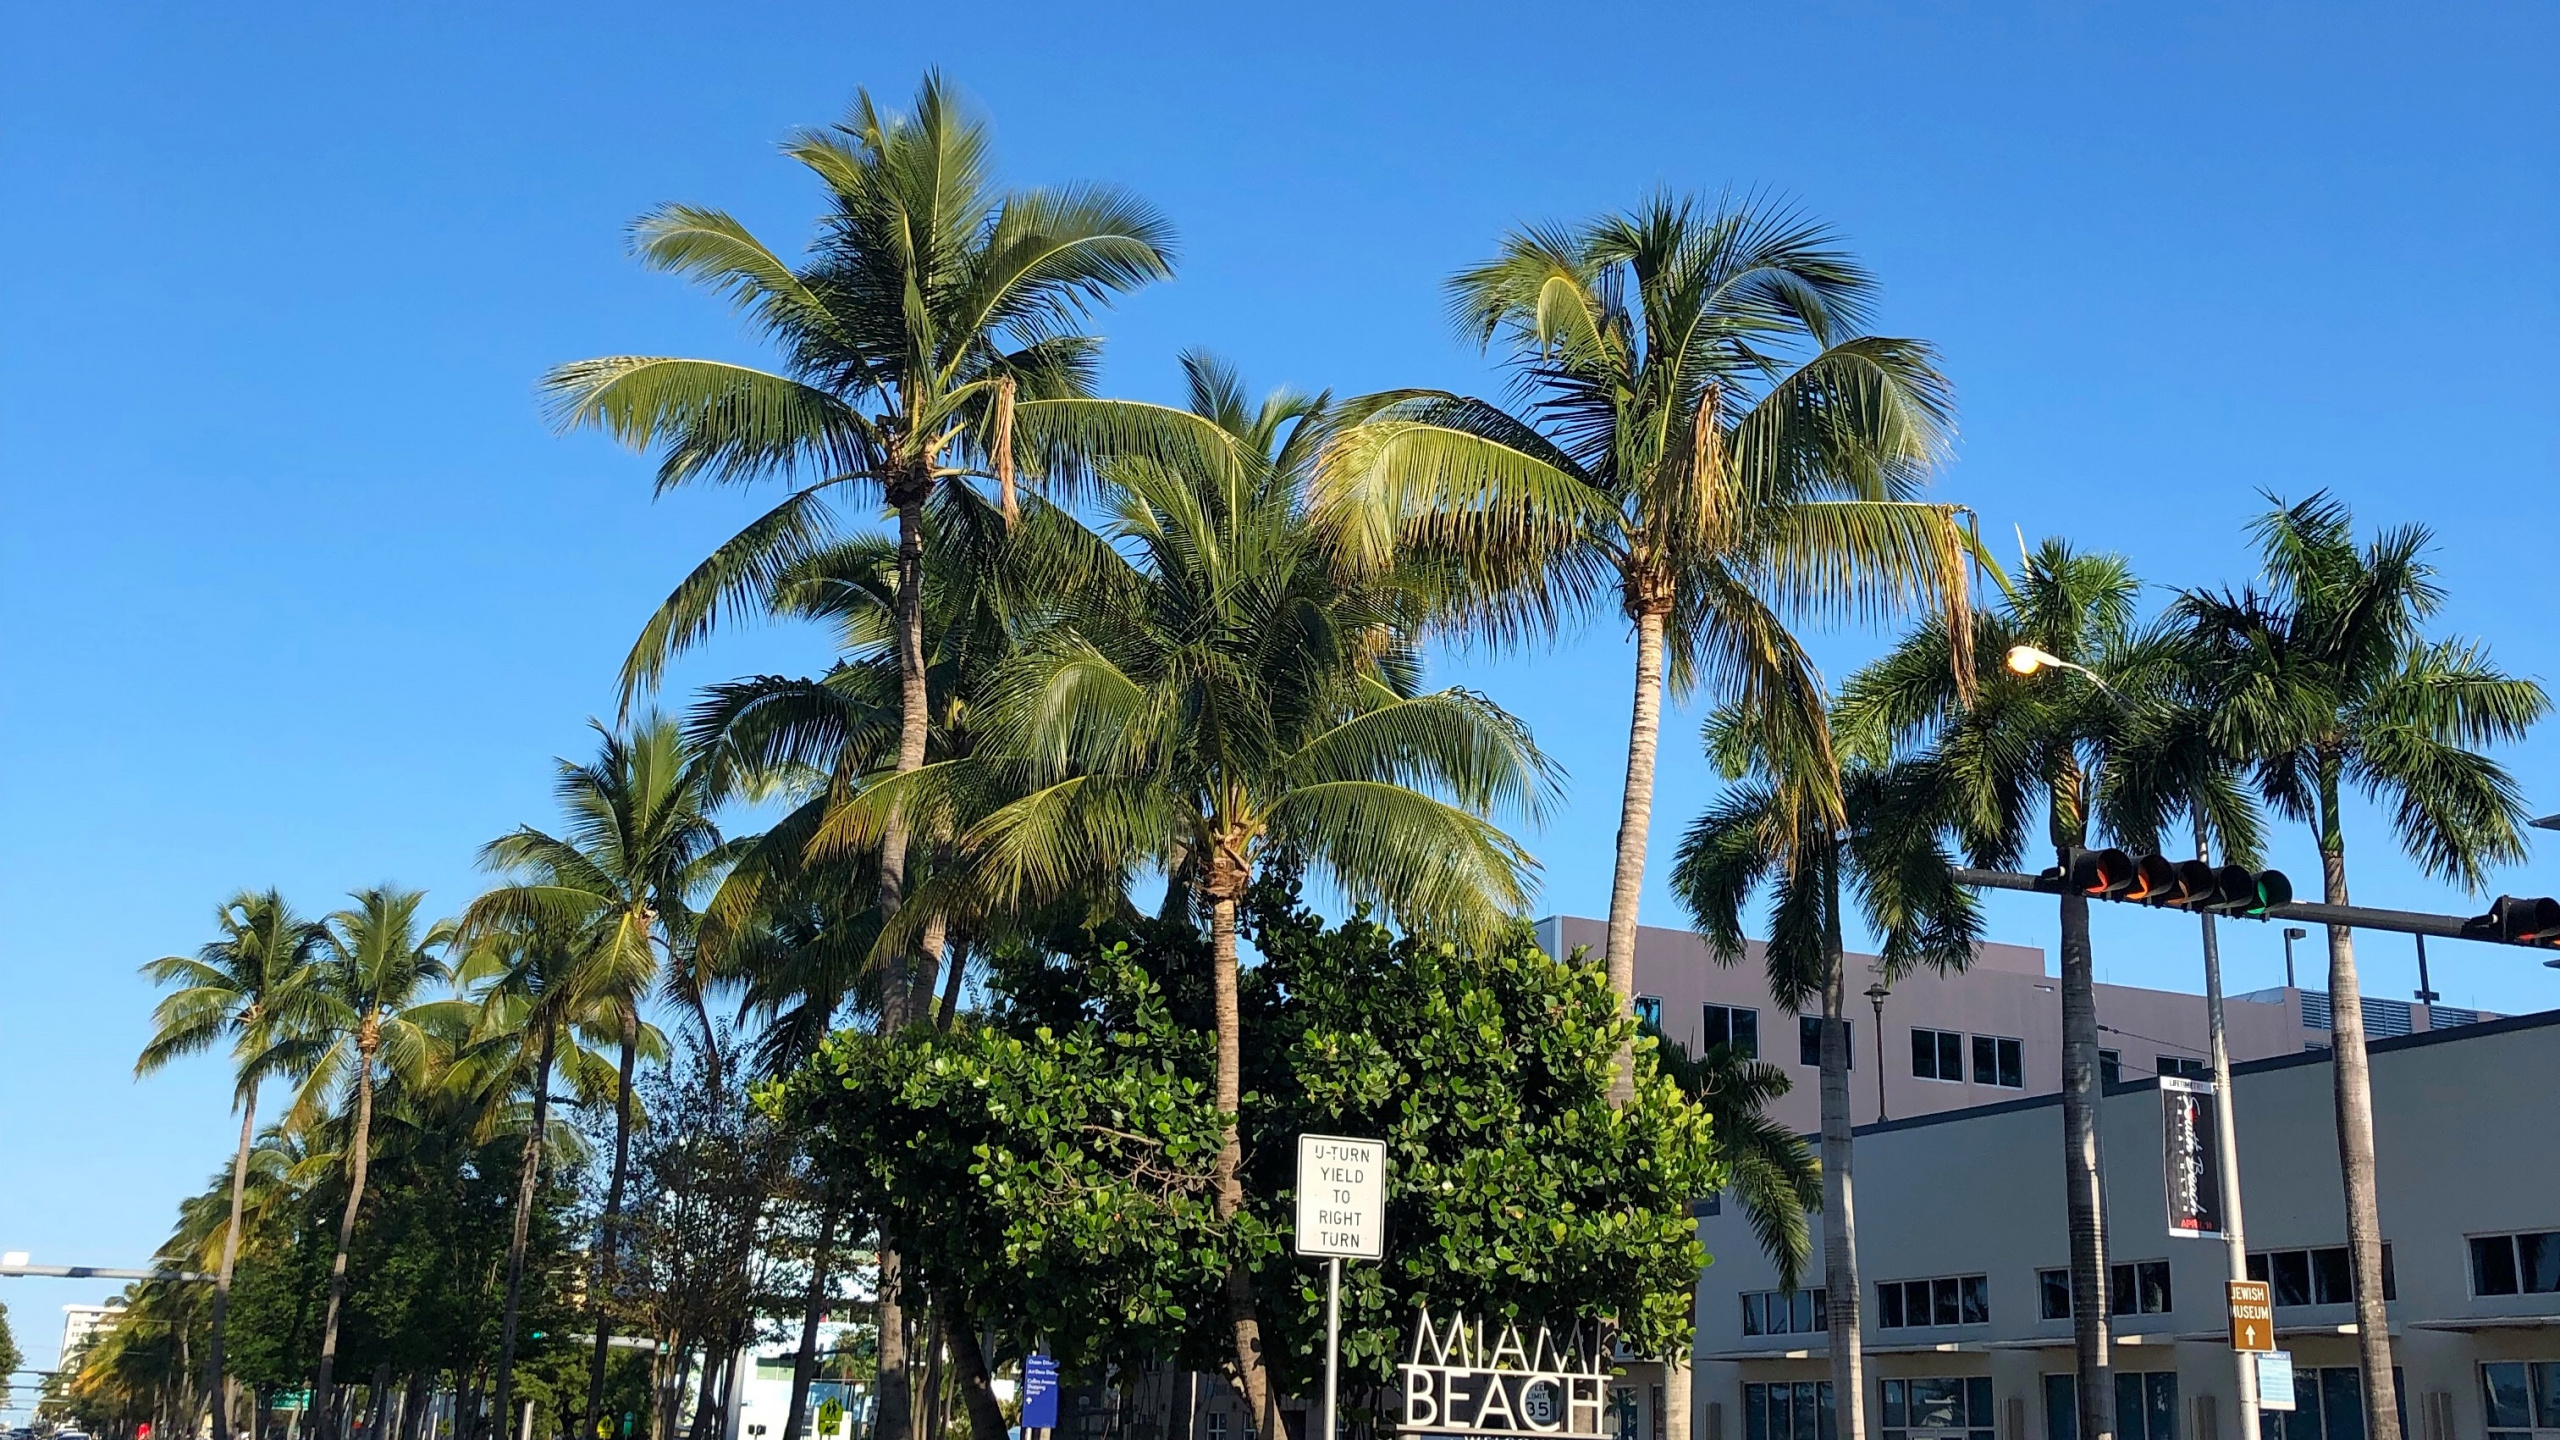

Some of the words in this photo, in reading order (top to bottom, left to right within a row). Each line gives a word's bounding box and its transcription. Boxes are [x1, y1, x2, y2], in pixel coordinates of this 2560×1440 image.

[2183, 1094, 2204, 1153] South
[1315, 1145, 1370, 1163] U-TURN
[1320, 1166, 1364, 1184] YIELD
[2186, 1155, 2208, 1216] Beach
[1333, 1189, 1351, 1204] TO
[1319, 1209, 1362, 1227] RIGHT
[1320, 1231, 1360, 1248] TURN
[2231, 1286, 2265, 1301] JEWISH
[2229, 1304, 2269, 1320] MUSEUM
[1412, 1306, 1600, 1376] MIAMI
[1406, 1368, 1602, 1435] BEACH
[1527, 1392, 1546, 1400] LIMIT
[1526, 1401, 1549, 1417] 35
